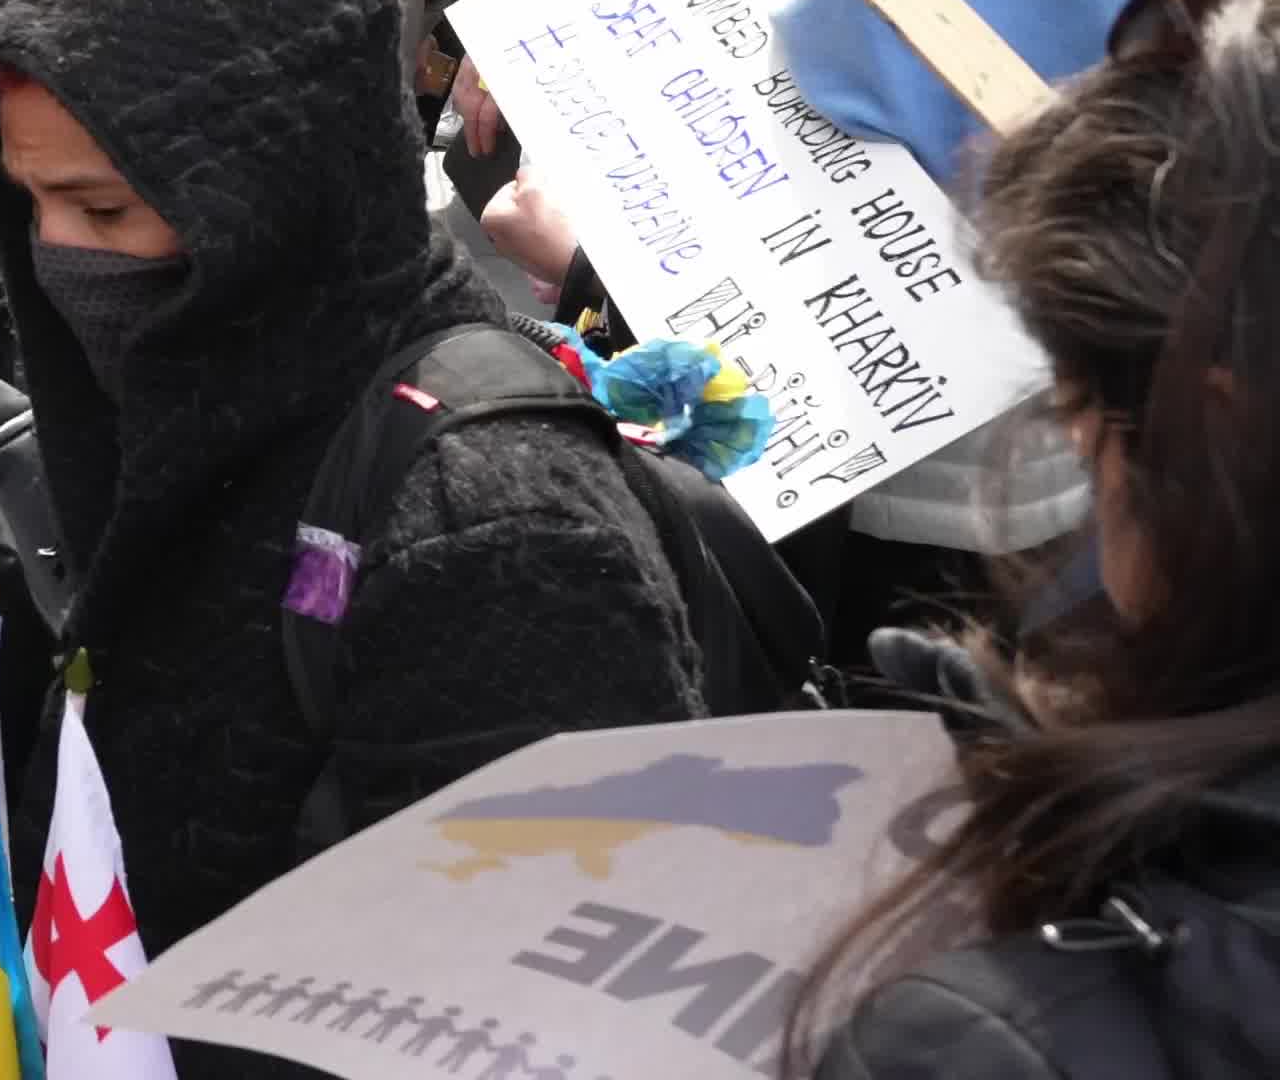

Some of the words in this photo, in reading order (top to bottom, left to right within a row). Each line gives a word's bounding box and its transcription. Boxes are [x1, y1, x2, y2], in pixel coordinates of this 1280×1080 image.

[660, 69, 790, 201] CHILDREN
[760, 209, 833, 266] IN
[803, 273, 955, 434] KHARKIV
[851, 187, 962, 302] HOUSE
